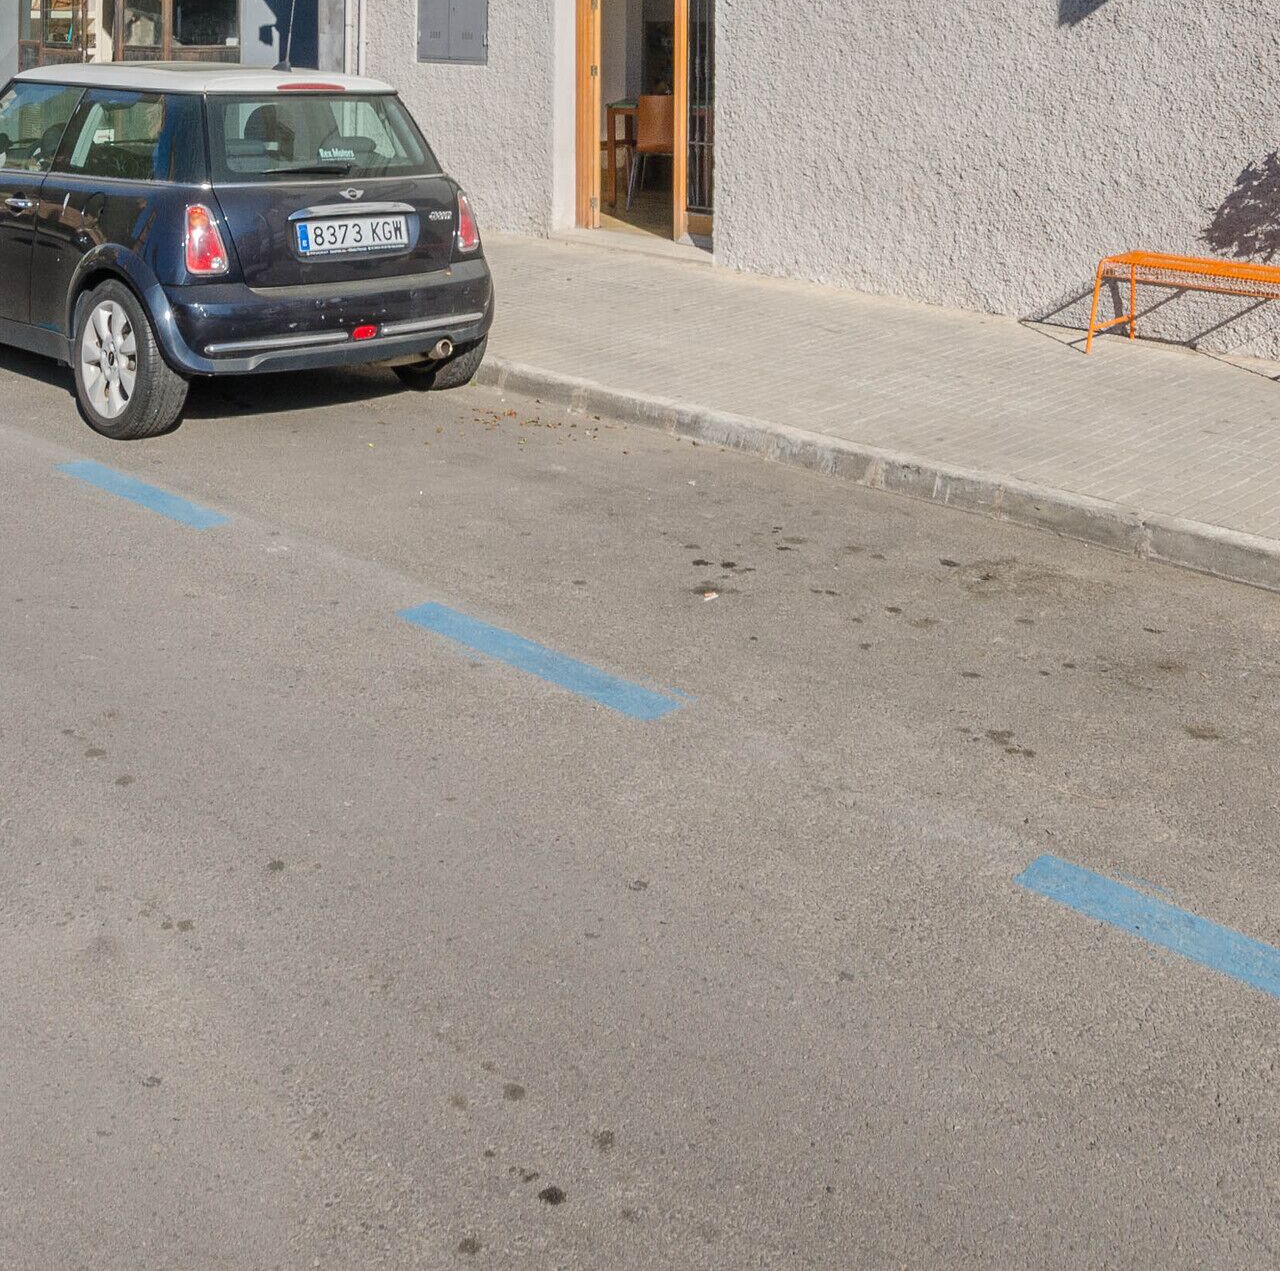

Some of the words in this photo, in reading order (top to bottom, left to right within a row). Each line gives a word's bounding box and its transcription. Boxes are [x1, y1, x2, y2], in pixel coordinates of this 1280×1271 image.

[318, 147, 332, 158] Rex
[331, 147, 355, 158] Motors
[313, 222, 363, 246] 8373
[370, 219, 403, 242] KGW
